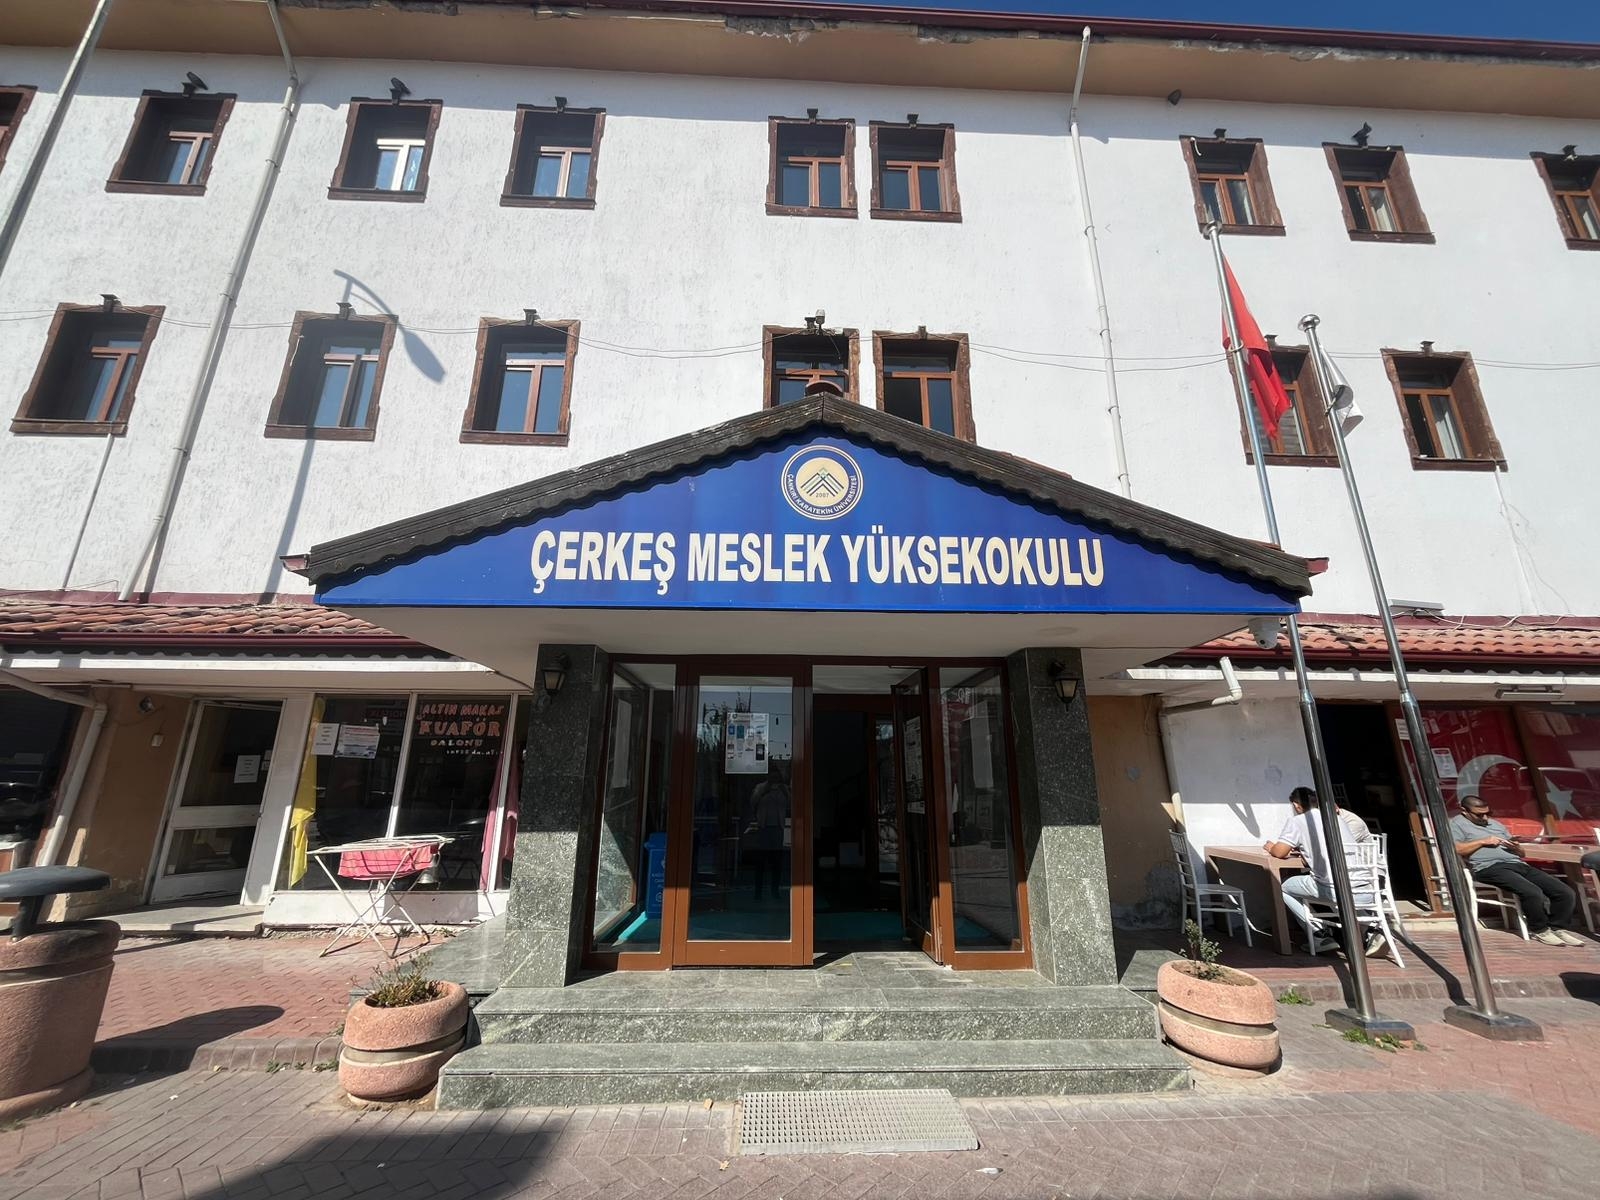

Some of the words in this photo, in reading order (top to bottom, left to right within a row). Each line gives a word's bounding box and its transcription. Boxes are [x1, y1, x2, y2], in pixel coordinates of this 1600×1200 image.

[796, 498, 833, 514] KARATEKİN
[530, 530, 676, 596] ÇERKEŞ
[687, 533, 832, 583] MESLEK
[841, 525, 1105, 586] YÜKSEKOKULU
[460, 704, 504, 716] MAKAS
